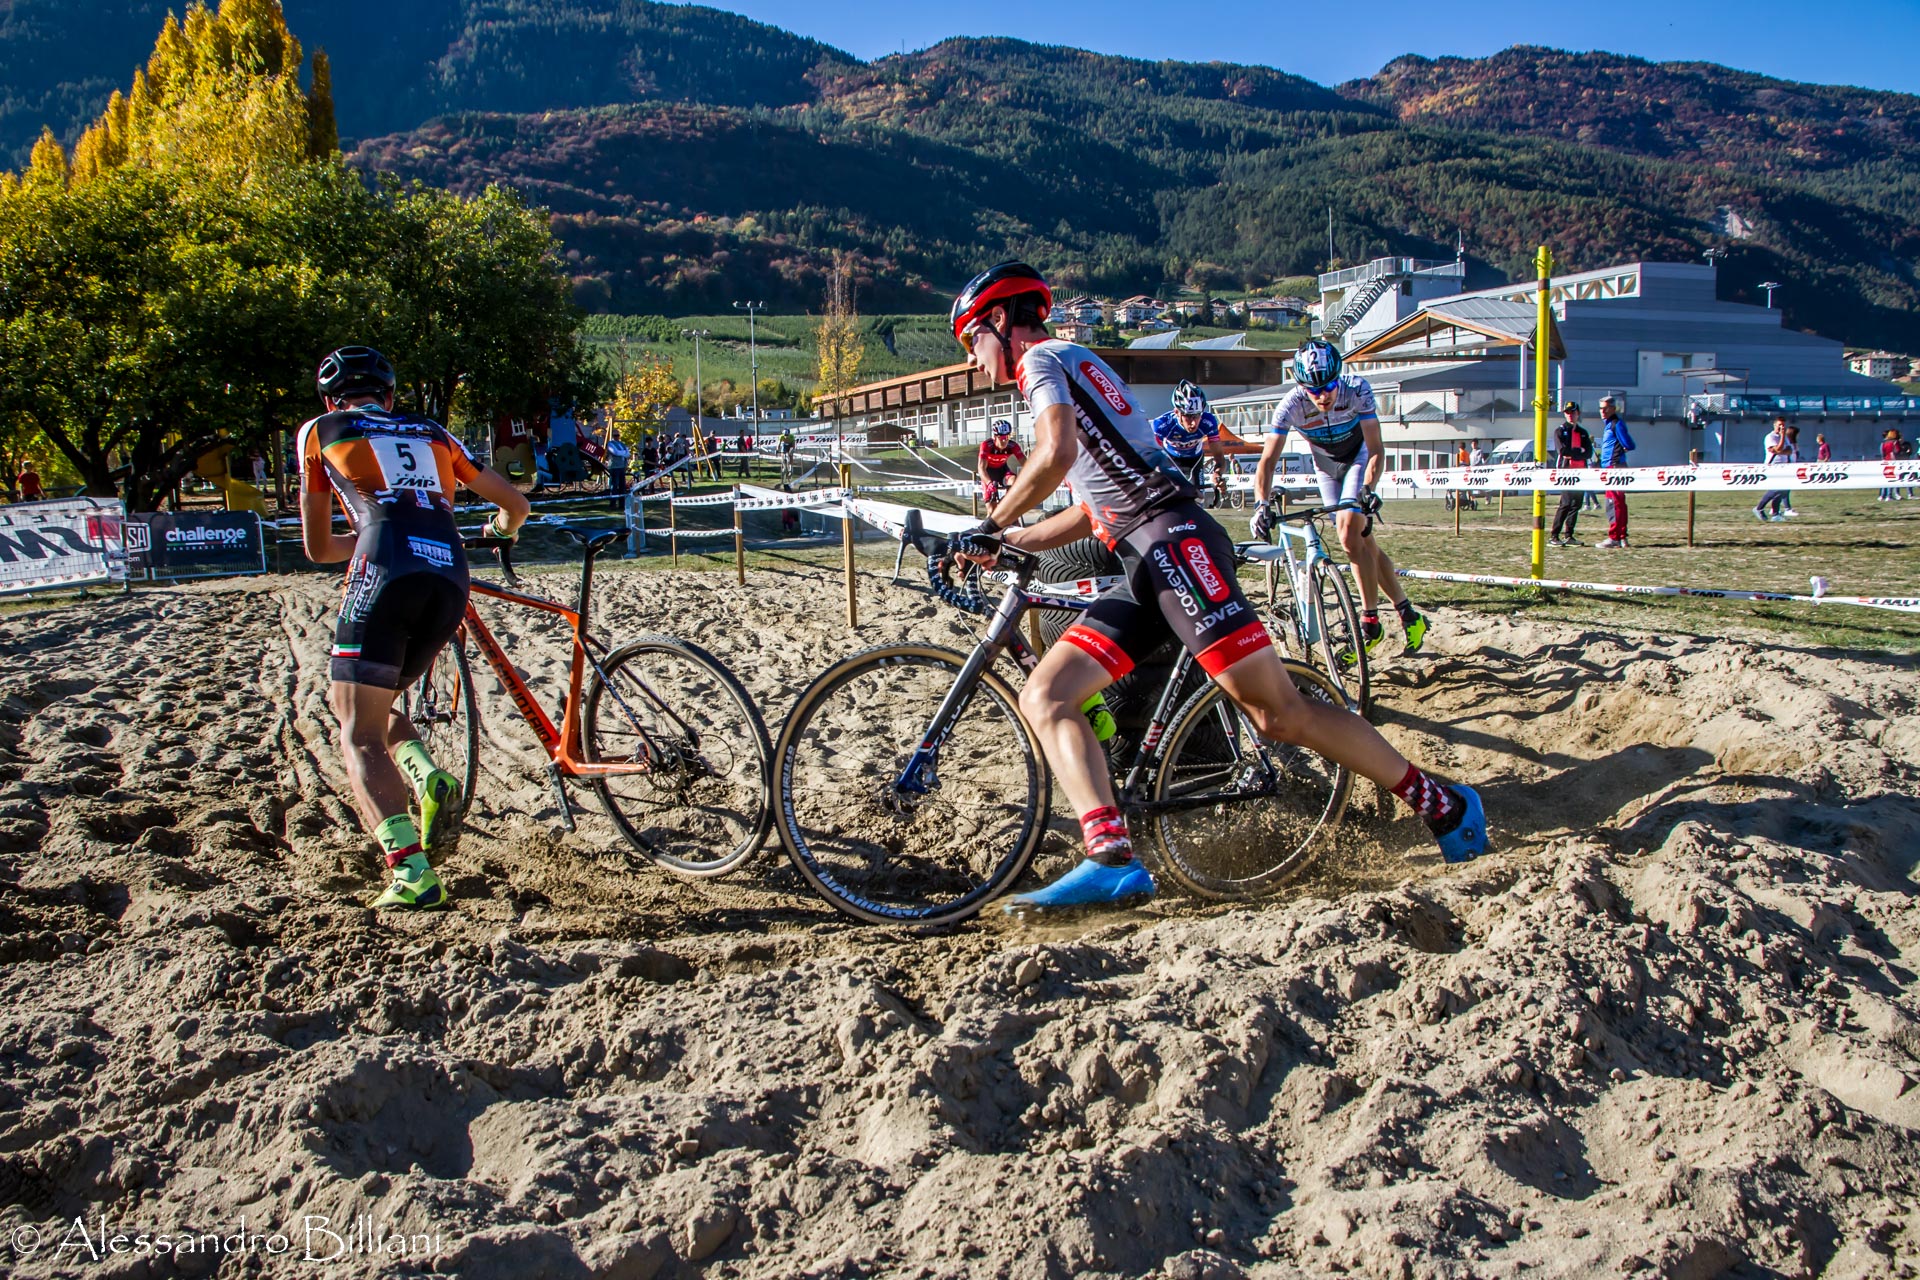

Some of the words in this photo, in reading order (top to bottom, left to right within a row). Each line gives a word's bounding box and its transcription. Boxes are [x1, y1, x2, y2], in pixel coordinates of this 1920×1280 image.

[1087, 365, 1126, 412] TECNOZOO
[1188, 400, 1199, 411] 21
[394, 442, 417, 472] 5
[391, 478, 436, 488] SMP
[1395, 477, 1413, 485] SMP
[1430, 477, 1449, 485] SMP
[1467, 477, 1489, 486] SMP
[1508, 477, 1532, 486] SMP
[1554, 476, 1580, 486] SMP
[1605, 476, 1635, 486] SMP
[1661, 475, 1697, 486] SMP
[1726, 473, 1768, 485] SMP
[1801, 472, 1849, 484] SMP
[165, 526, 247, 544] challenge
[1187, 545, 1222, 597] TECNOZOO
[1153, 548, 1199, 617] COGEVAP
[1194, 601, 1244, 636] ADVEL
[495, 661, 552, 743] MOUNTAIN
